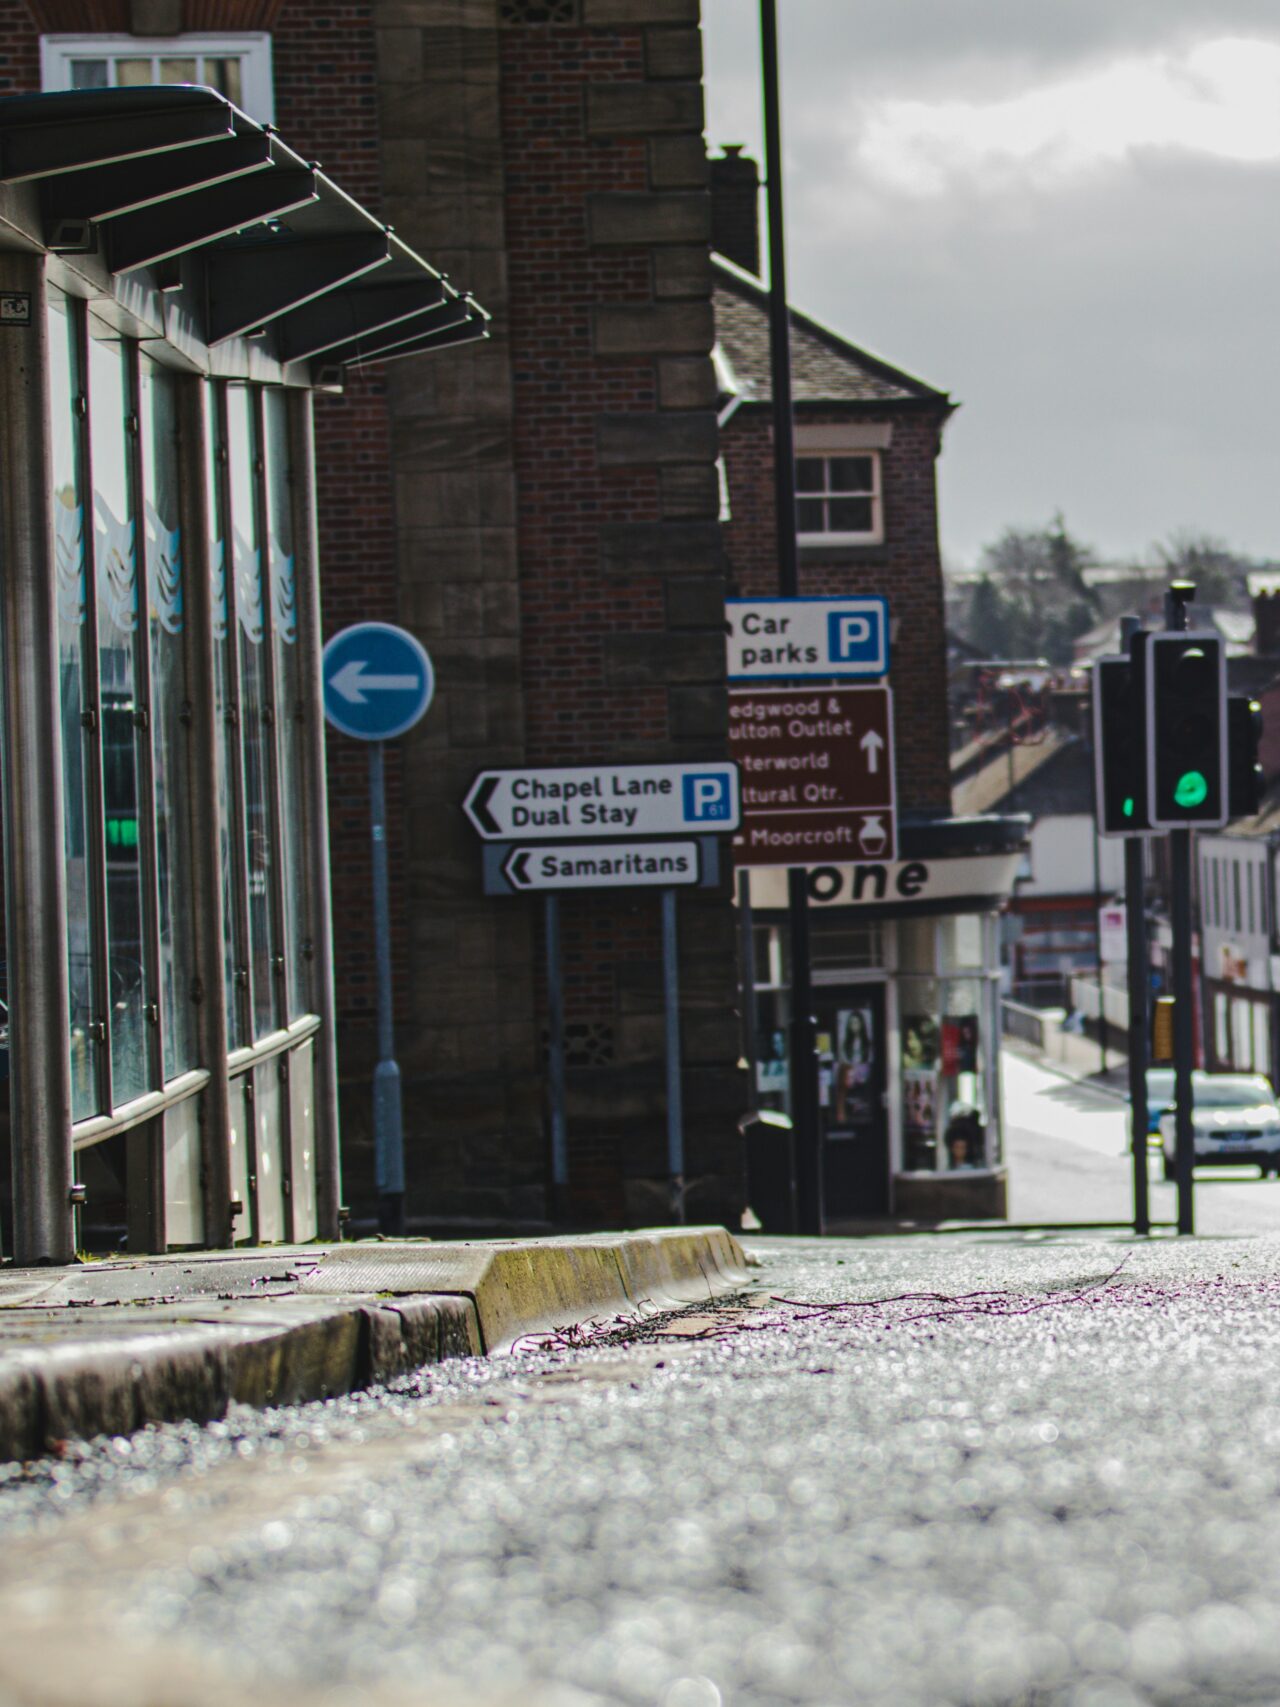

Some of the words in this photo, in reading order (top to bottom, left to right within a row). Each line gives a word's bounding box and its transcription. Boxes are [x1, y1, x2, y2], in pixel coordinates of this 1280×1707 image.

[741, 612, 790, 635] Car
[839, 617, 870, 657] P
[741, 642, 818, 668] parks
[729, 700, 820, 720] edgwood
[828, 698, 841, 714] &
[729, 721, 781, 739] ulton
[788, 720, 853, 738] Outlet
[744, 752, 830, 771] terworld
[511, 776, 602, 801] Chapel
[612, 775, 672, 796] Lane
[694, 779, 721, 816] P
[742, 785, 797, 803] ltural
[804, 783, 844, 802] Qtr.
[511, 805, 570, 827] Dual
[580, 804, 638, 827] Stay
[751, 826, 853, 846] Moorcroft
[541, 853, 689, 877] Samaritans
